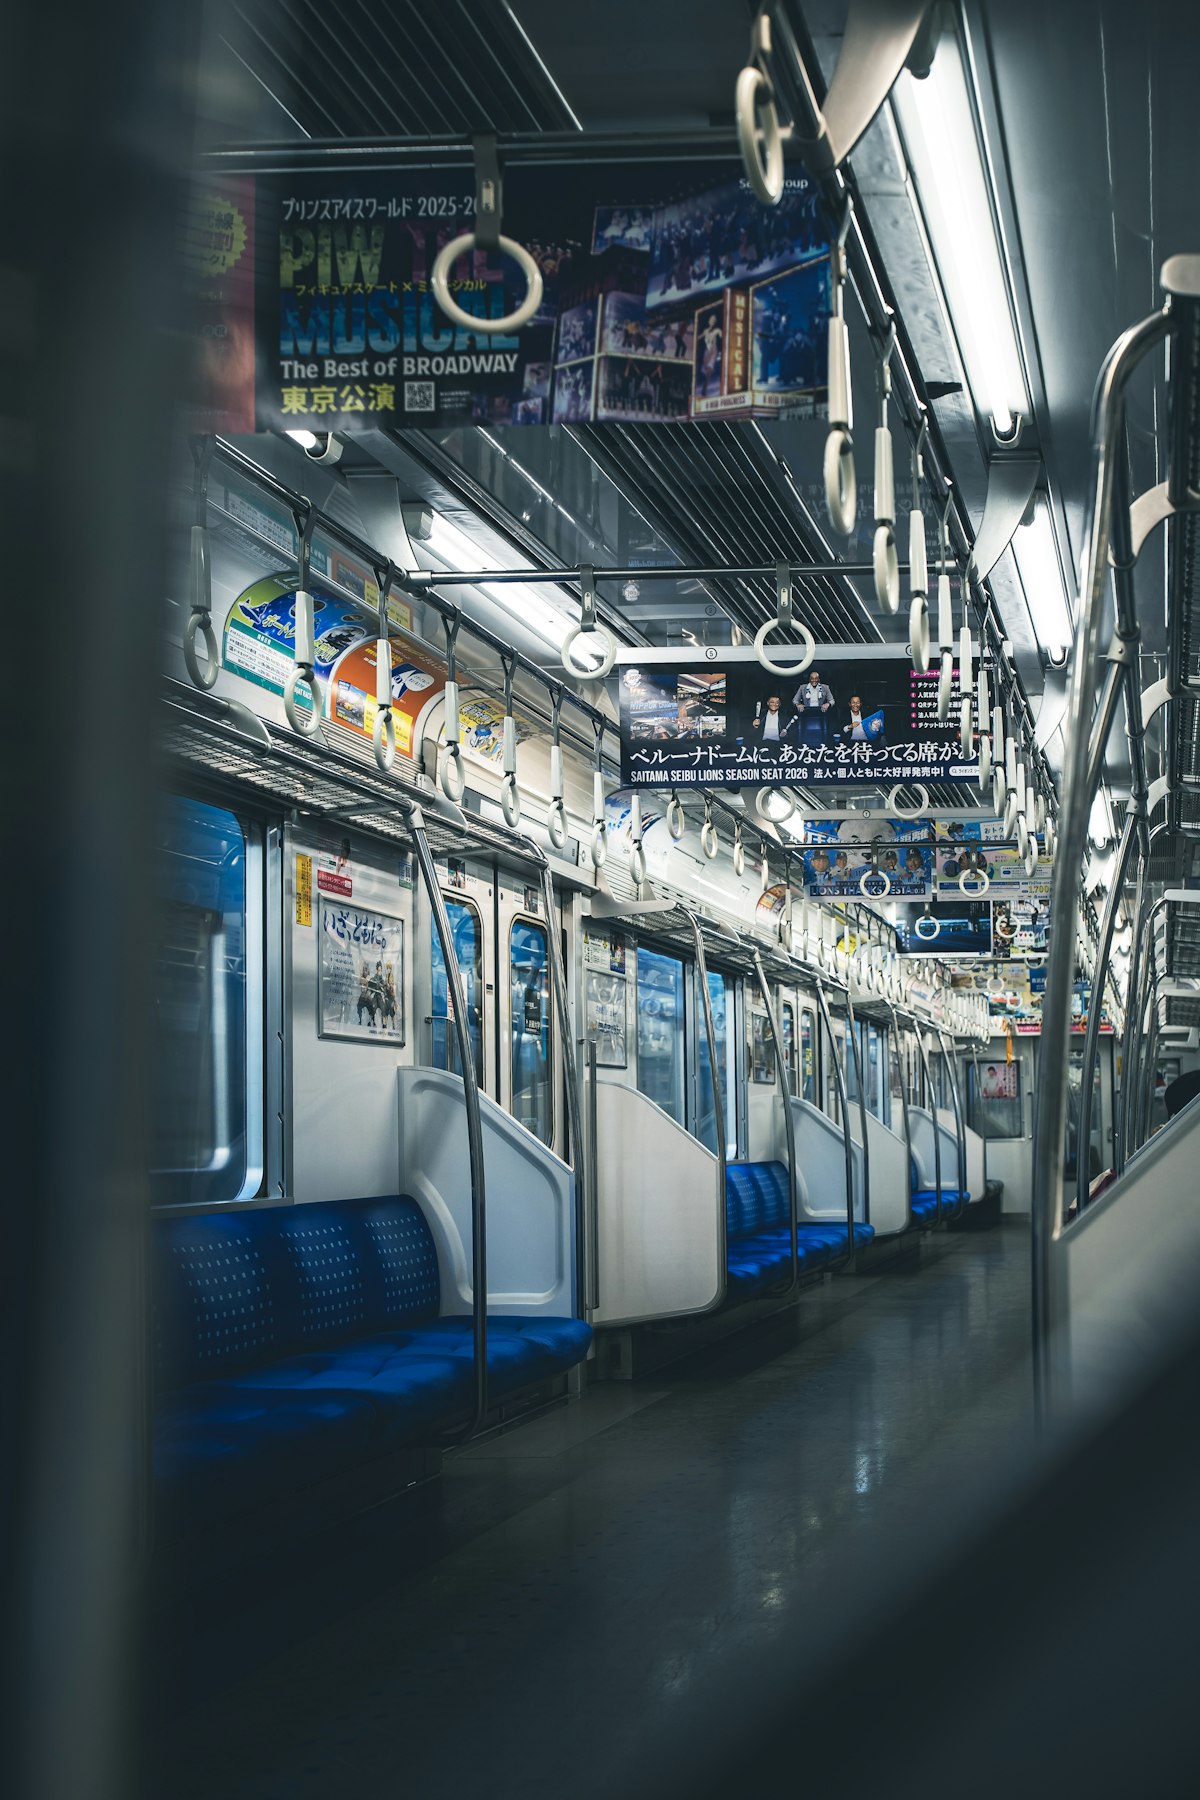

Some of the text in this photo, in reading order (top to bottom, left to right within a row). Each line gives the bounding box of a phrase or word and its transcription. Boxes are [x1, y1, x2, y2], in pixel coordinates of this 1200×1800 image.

[282, 195, 413, 221] プリンスアイスワールド
[278, 222, 386, 288] PIW
[295, 281, 398, 297] フィギュアスケート
[417, 279, 487, 293] ミジカル
[279, 285, 520, 356] MUSICAL
[733, 294, 746, 391] MUSICAL
[280, 353, 519, 379] The Best of BROADWAY
[280, 382, 396, 415] 東京公演
[629, 740, 992, 766] ベルーナドームに、あなたを待ってる席が
[630, 766, 944, 783] SAITAMA SEIBU LIONS SEASON SEAT 2026 法人・個人ともに大好評発売中!
[810, 886, 840, 896] LIONS
[887, 885, 912, 895] ESTA
[322, 909, 387, 950] いざ、ともに。
